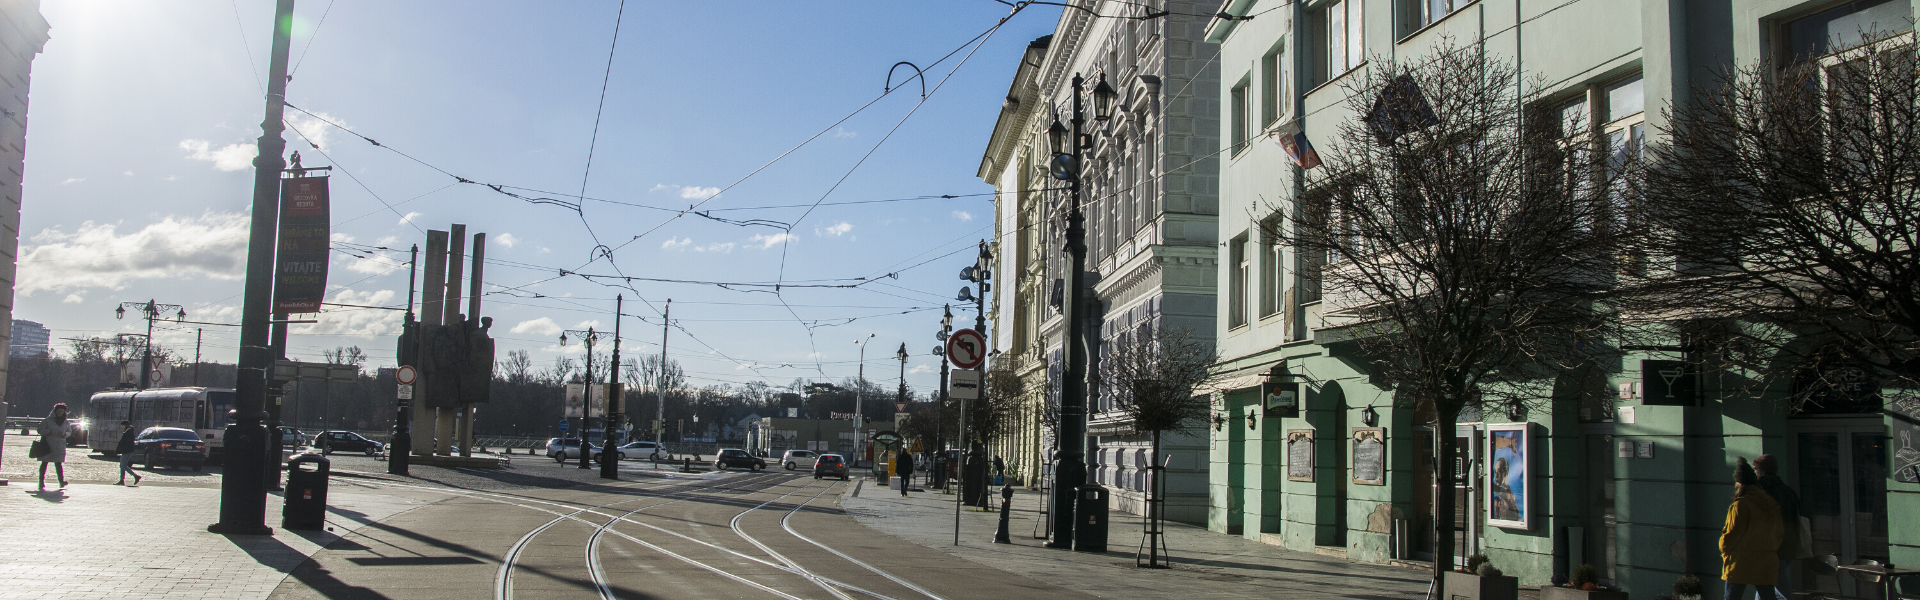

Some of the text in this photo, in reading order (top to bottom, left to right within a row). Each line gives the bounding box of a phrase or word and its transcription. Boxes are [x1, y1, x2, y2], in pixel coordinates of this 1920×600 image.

[313, 228, 326, 238] TO
[283, 239, 299, 250] NA
[283, 261, 322, 275] VITAJTE
[281, 276, 320, 284] WELCOME
